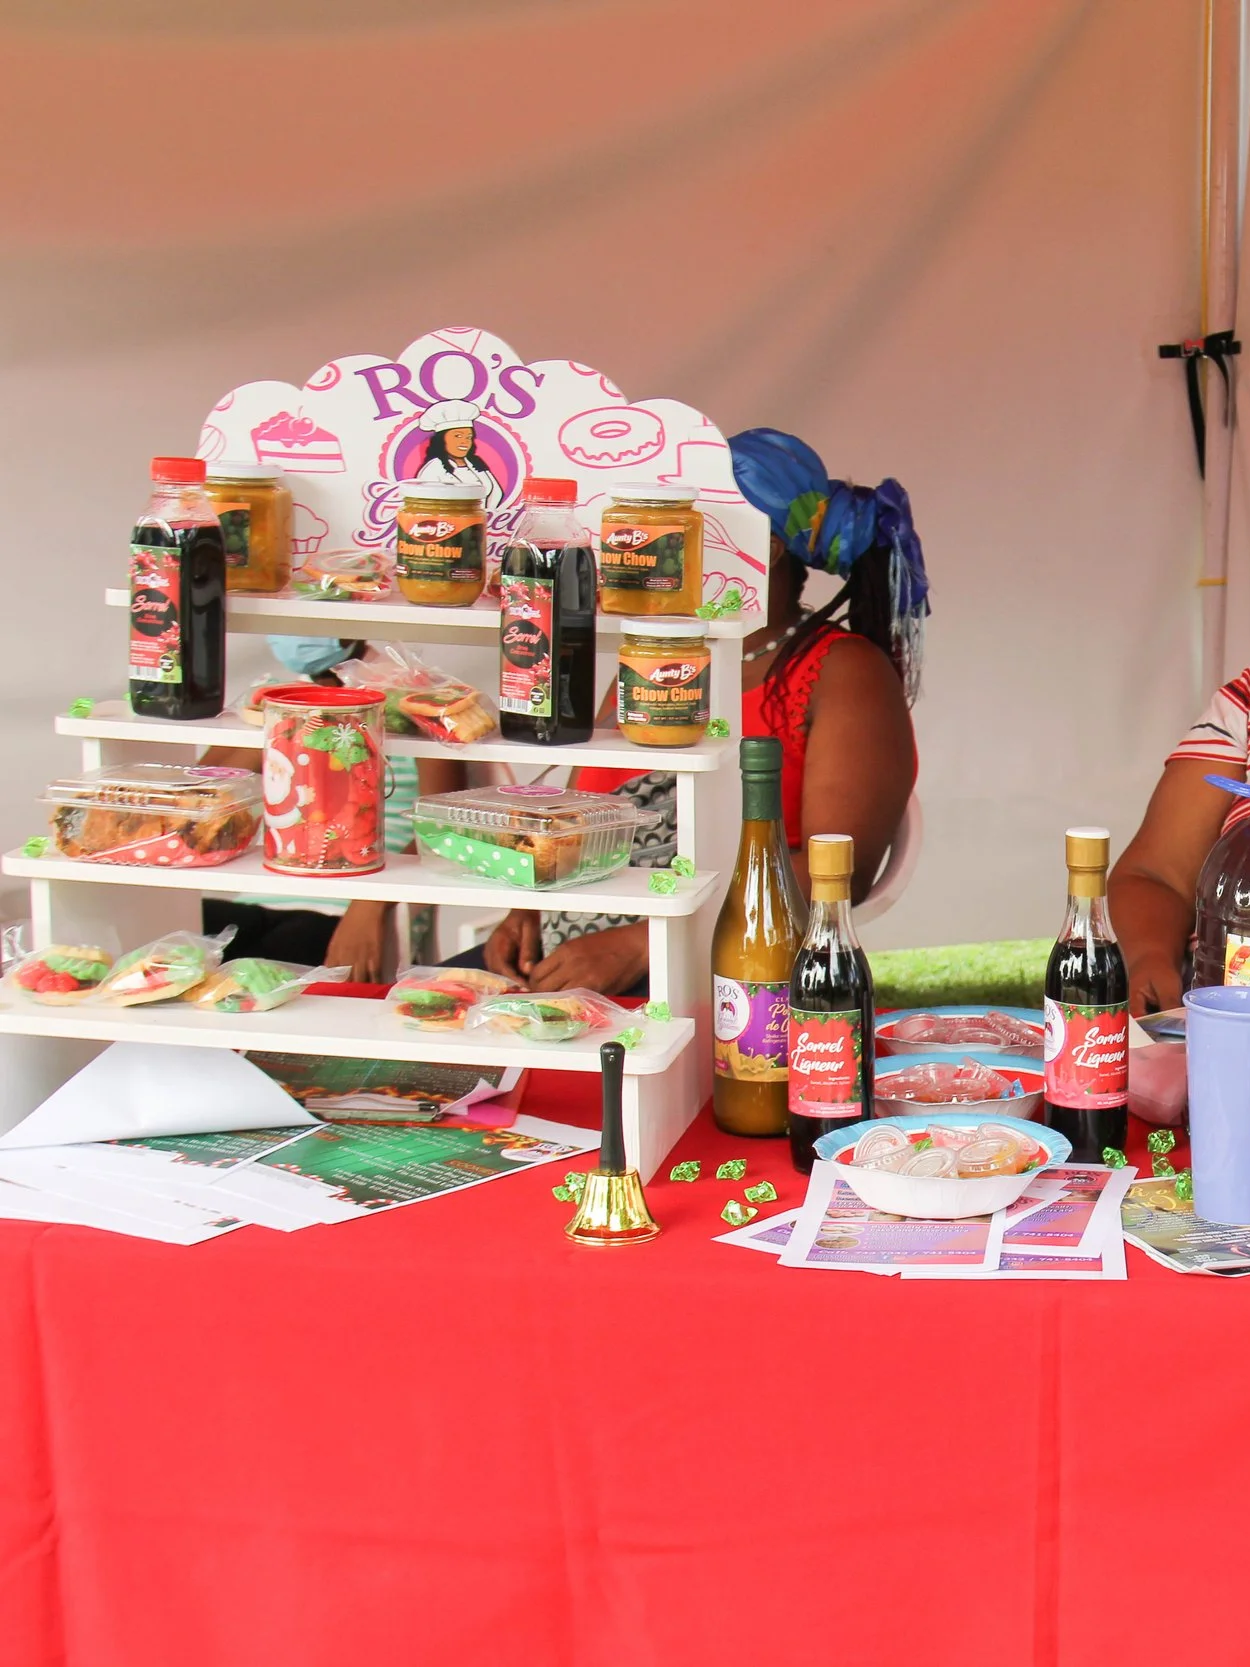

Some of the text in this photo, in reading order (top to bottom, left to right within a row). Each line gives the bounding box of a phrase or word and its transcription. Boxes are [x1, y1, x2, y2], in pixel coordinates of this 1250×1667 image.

[354, 351, 545, 421] RO'S
[606, 530, 649, 546] Aunty B's
[425, 543, 463, 558] Chow
[623, 551, 657, 567] Chow
[650, 664, 696, 682] Aunty B's
[632, 686, 703, 702] Chow Chow
[766, 1021, 779, 1031] de
[797, 1032, 844, 1053] Sorrel
[1084, 1026, 1126, 1047] Sorrel
[791, 1049, 845, 1075] Liqueur
[1071, 1044, 1126, 1068] Liqueur
